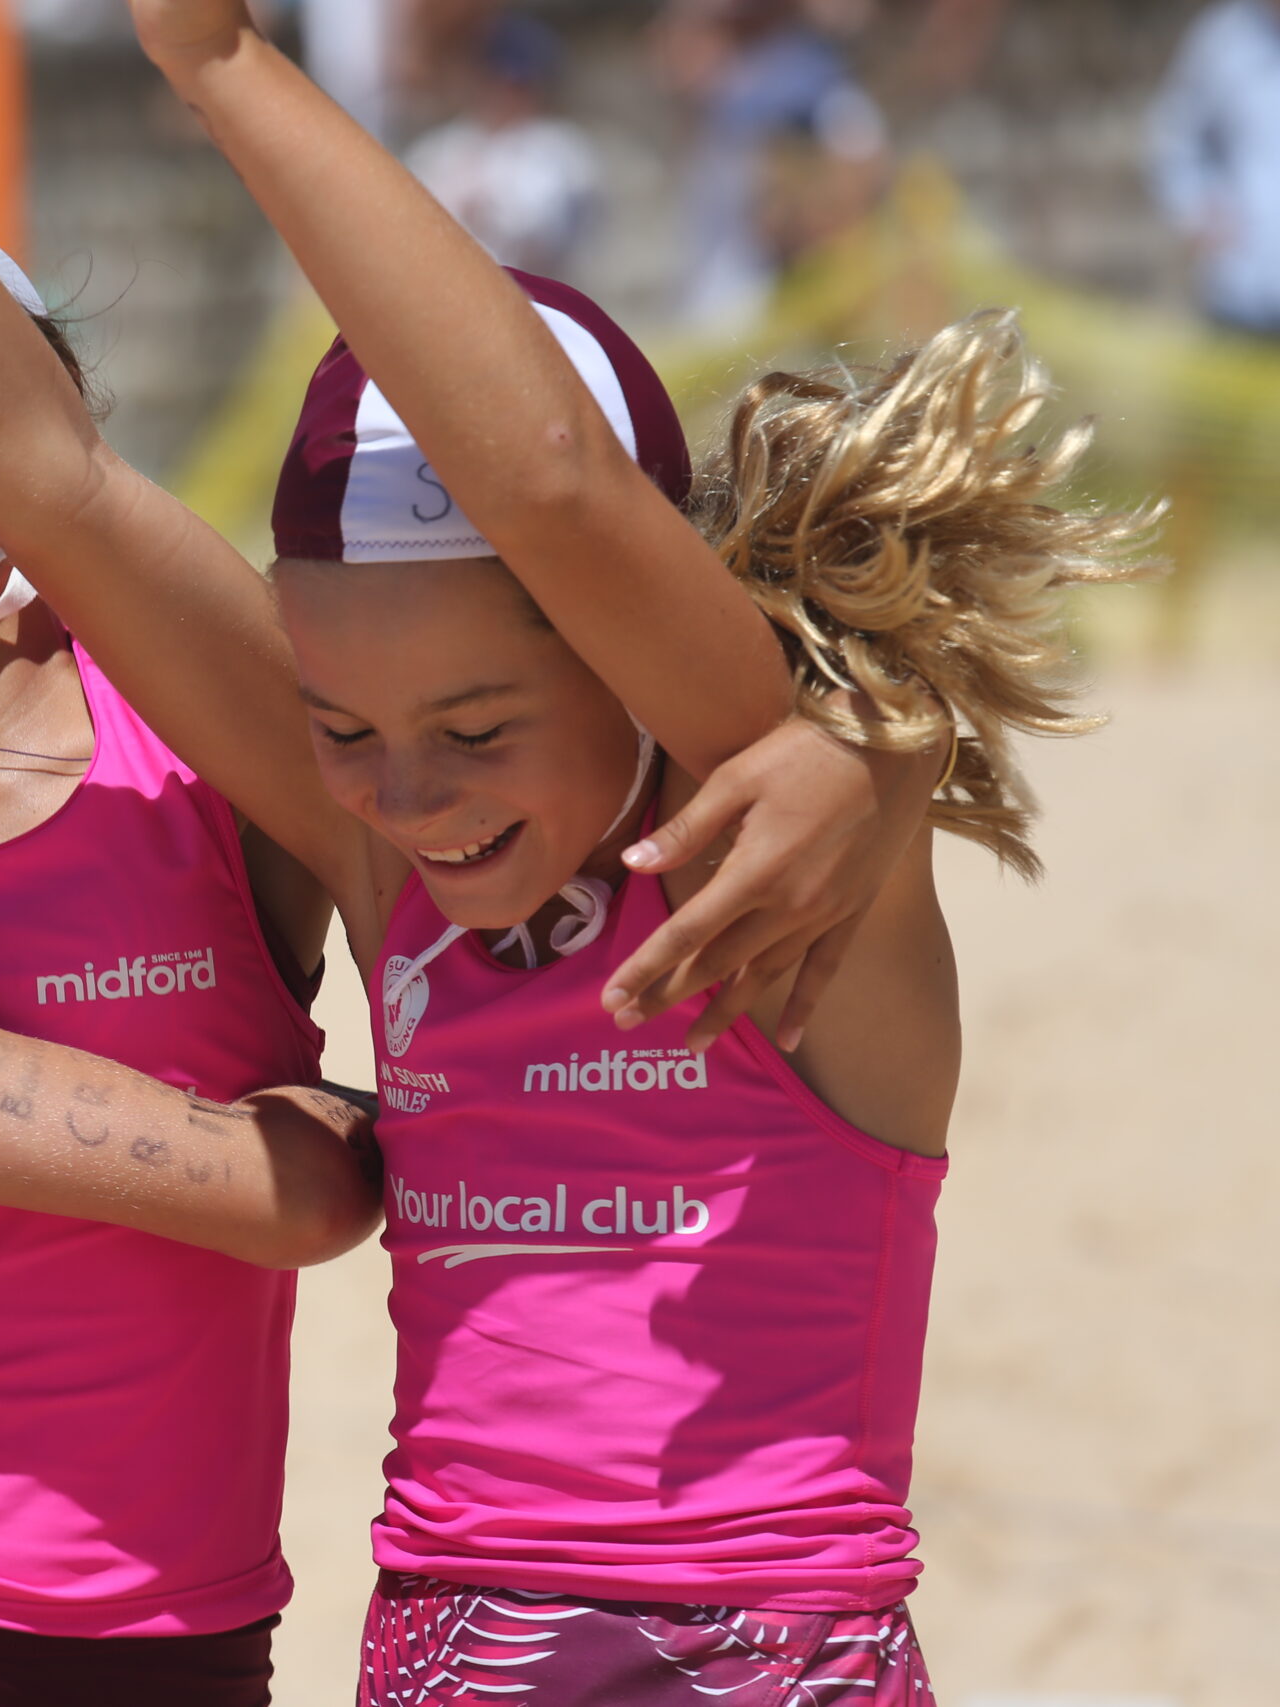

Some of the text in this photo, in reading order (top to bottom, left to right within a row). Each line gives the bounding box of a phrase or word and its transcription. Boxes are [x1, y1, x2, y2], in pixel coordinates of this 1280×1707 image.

[151, 952, 181, 964] SINCE
[36, 947, 217, 1005] midford
[631, 1048, 665, 1058] SINCE
[392, 1065, 451, 1093] SOUTH
[523, 1049, 708, 1092] midford
[383, 1085, 431, 1113] WALES
[390, 1173, 710, 1235] Your local club
